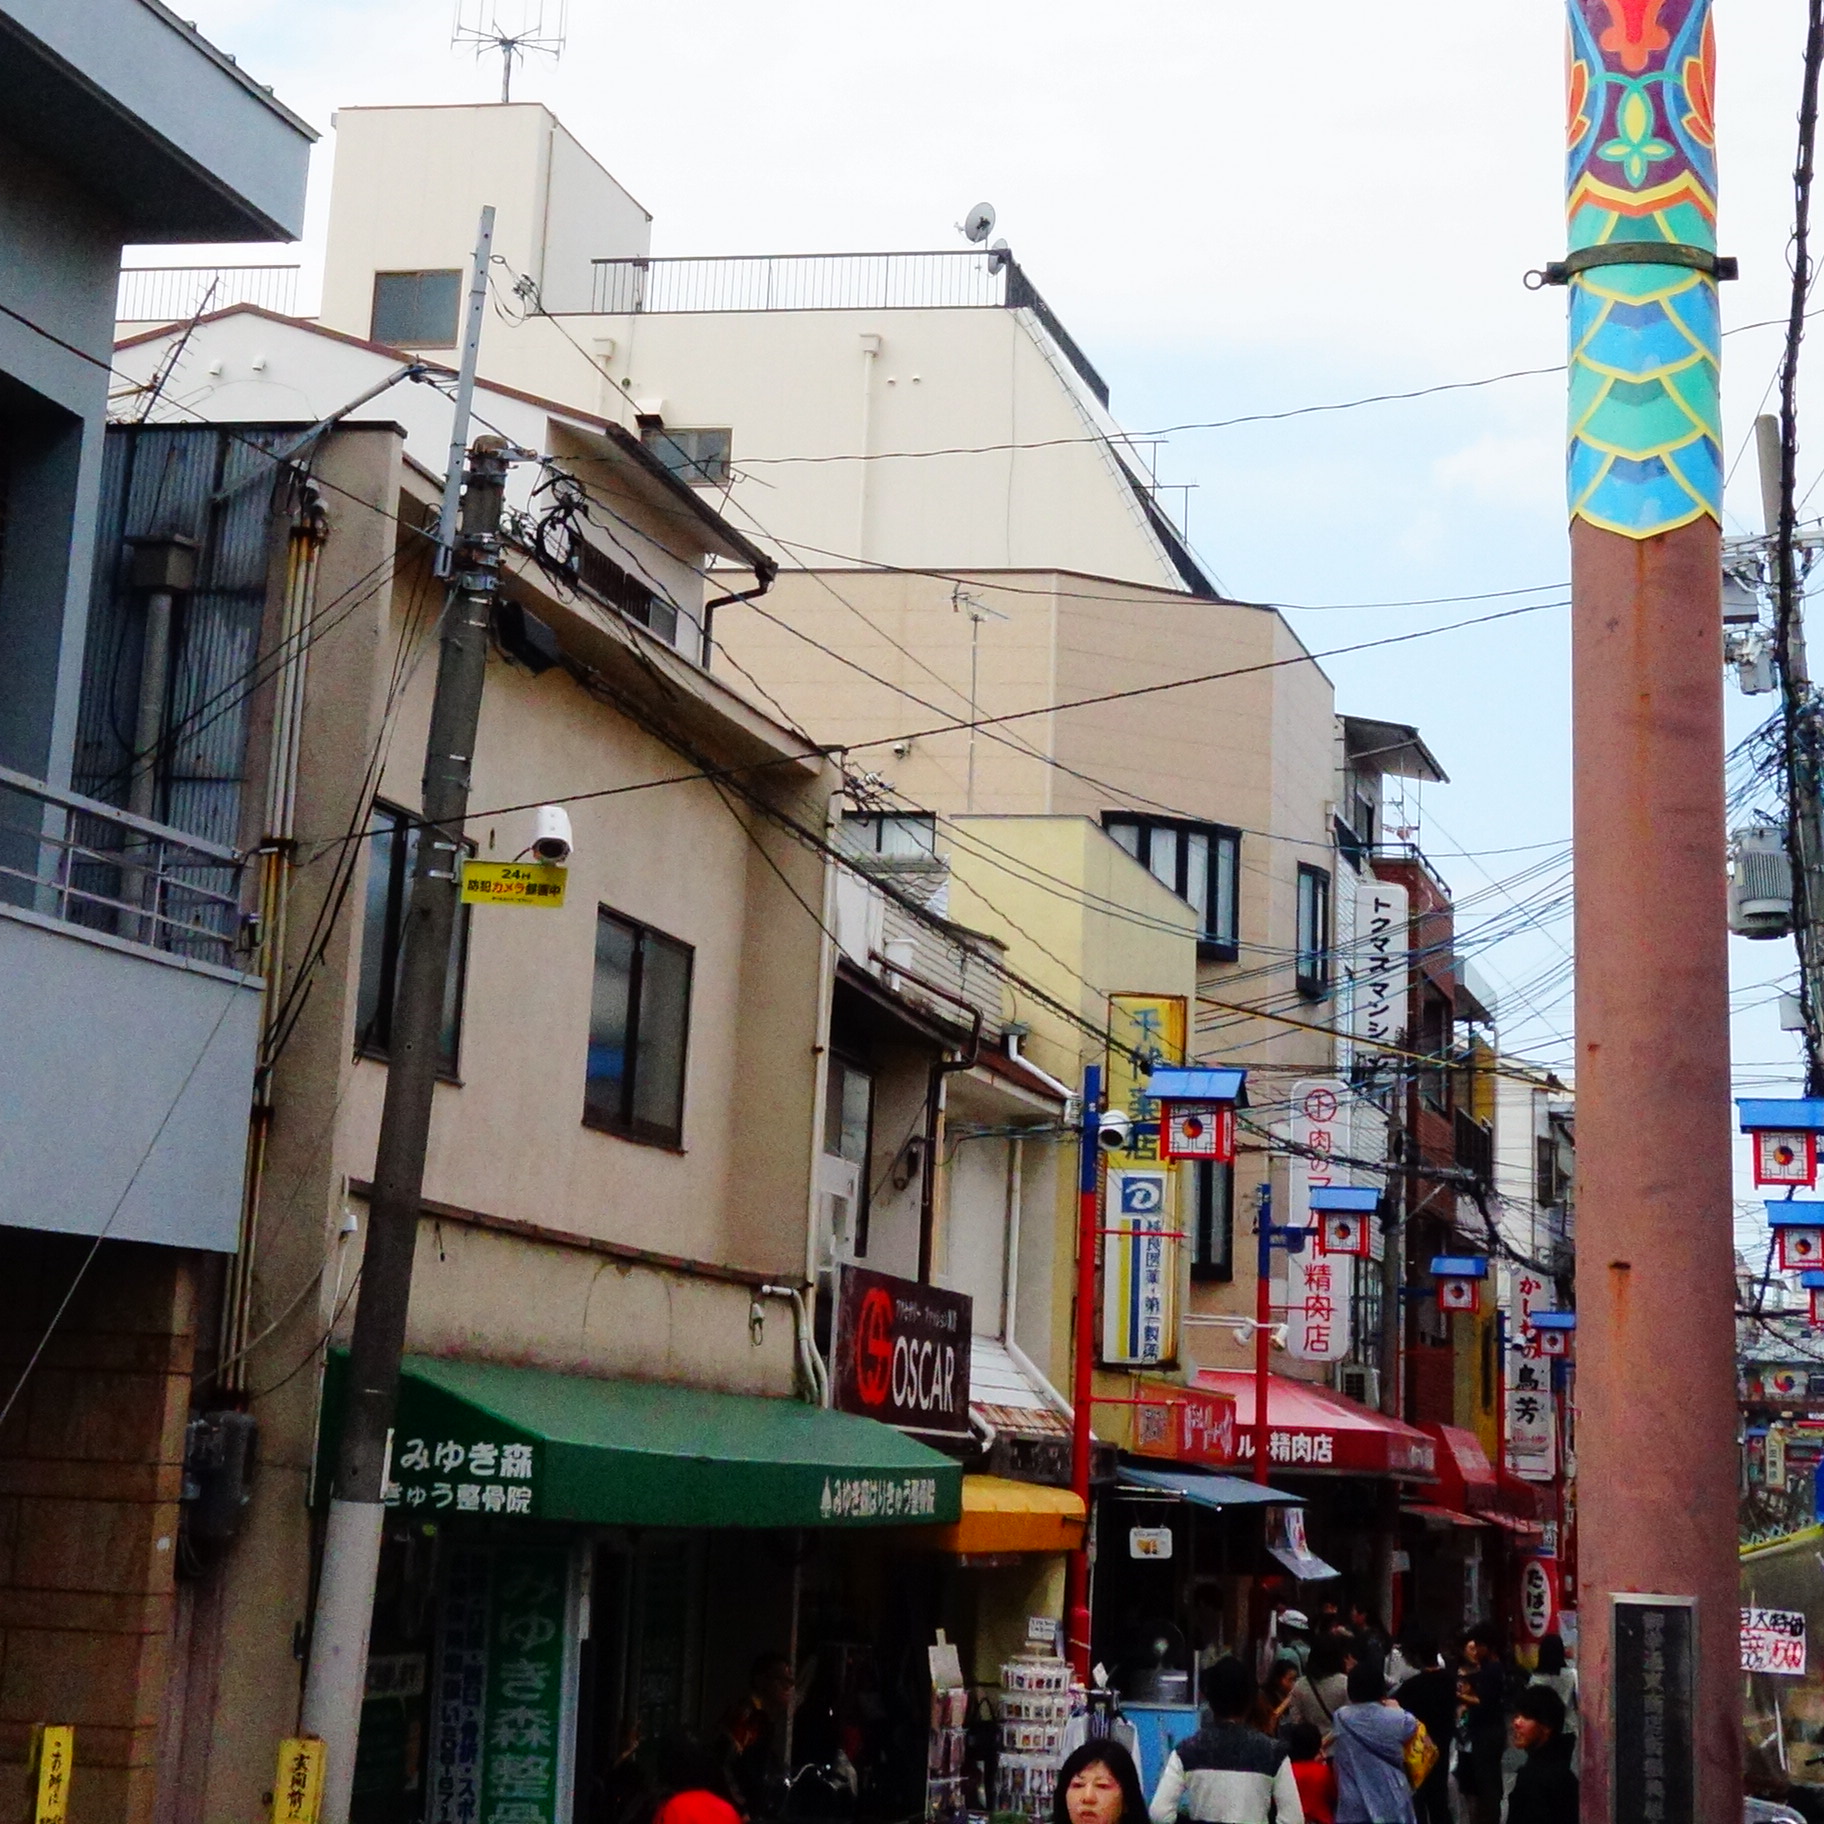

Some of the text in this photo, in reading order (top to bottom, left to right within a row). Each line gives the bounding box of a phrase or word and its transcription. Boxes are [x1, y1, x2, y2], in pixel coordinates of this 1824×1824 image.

[892, 1335, 955, 1413] OSCAR
[400, 1438, 534, 1479] みゆき森
